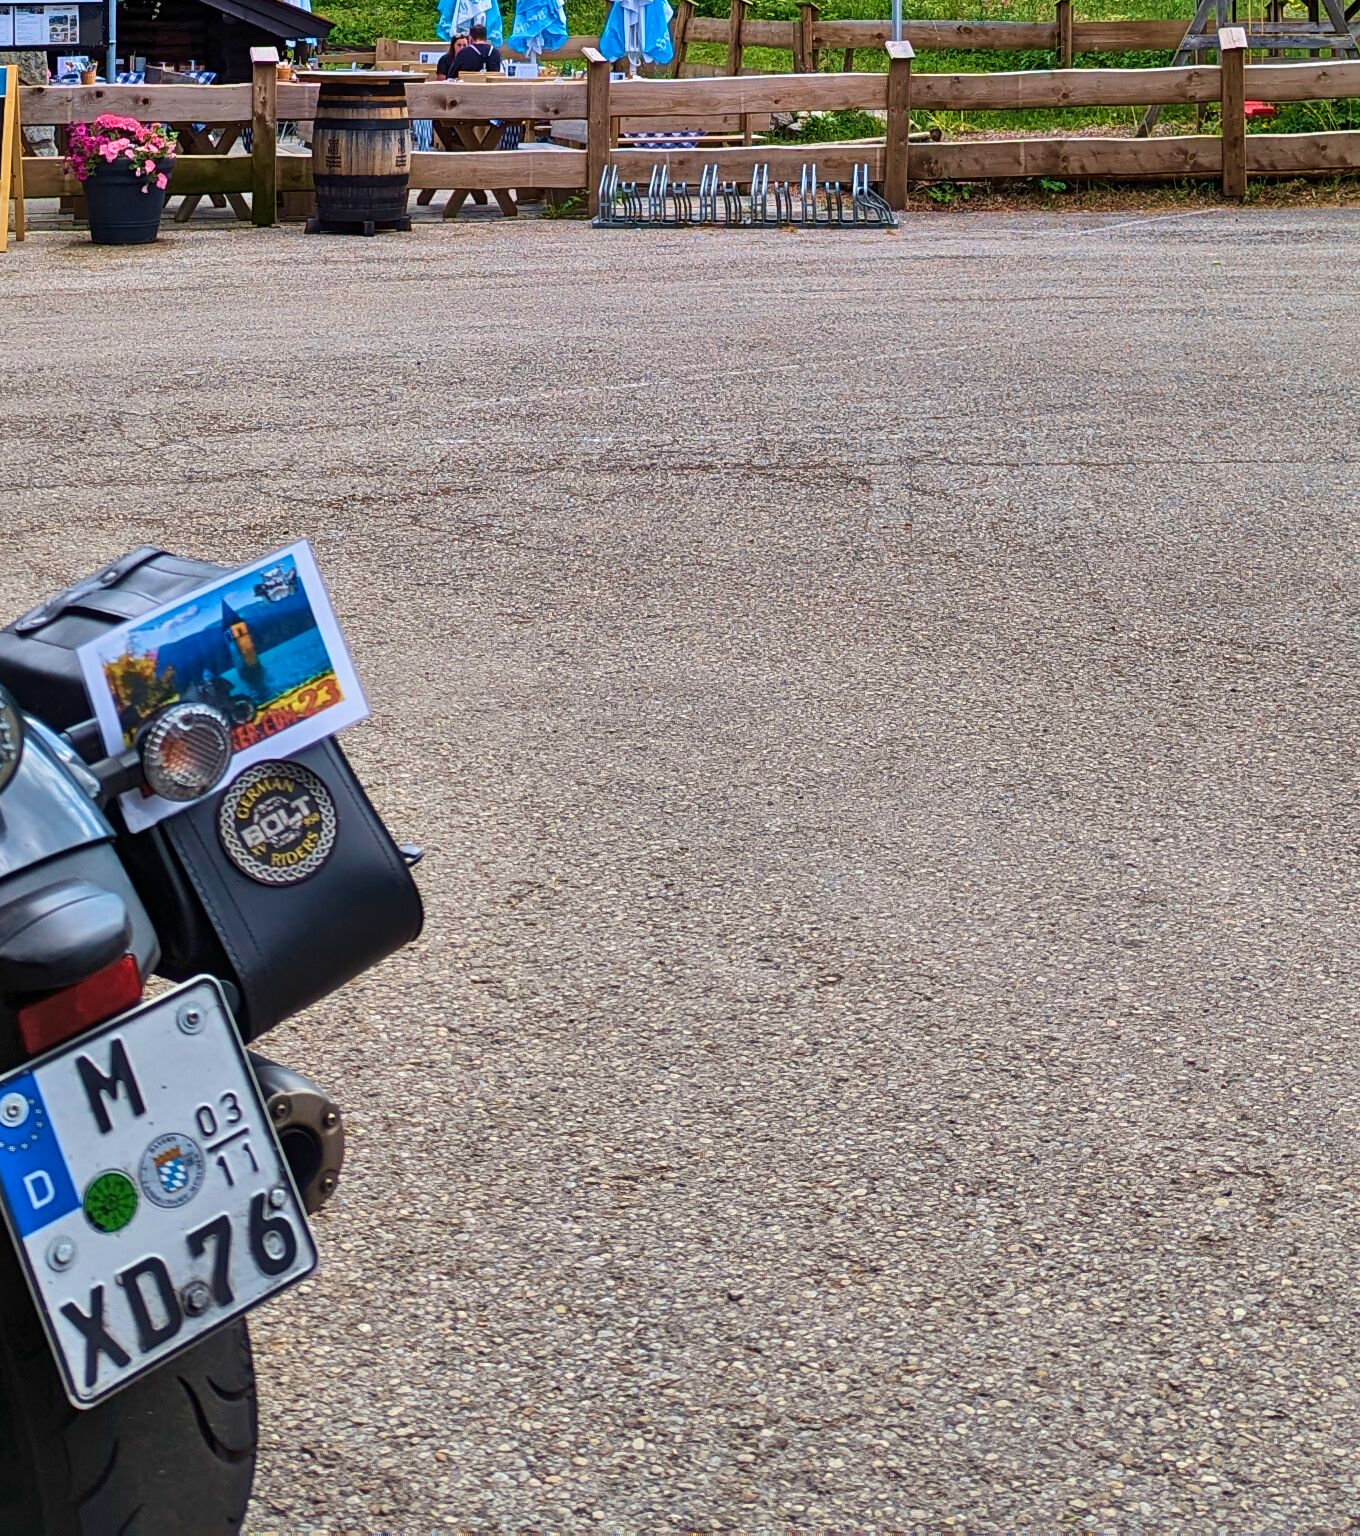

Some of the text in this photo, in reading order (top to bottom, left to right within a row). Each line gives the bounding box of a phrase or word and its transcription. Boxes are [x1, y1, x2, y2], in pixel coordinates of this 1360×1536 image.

[236, 776, 295, 820] GERMAN
[240, 795, 311, 849] BOLT
[270, 831, 319, 866] RIDERS
[75, 1038, 148, 1135] M
[194, 1092, 245, 1138] 03
[215, 1143, 260, 1187] 11
[22, 1170, 56, 1211] D
